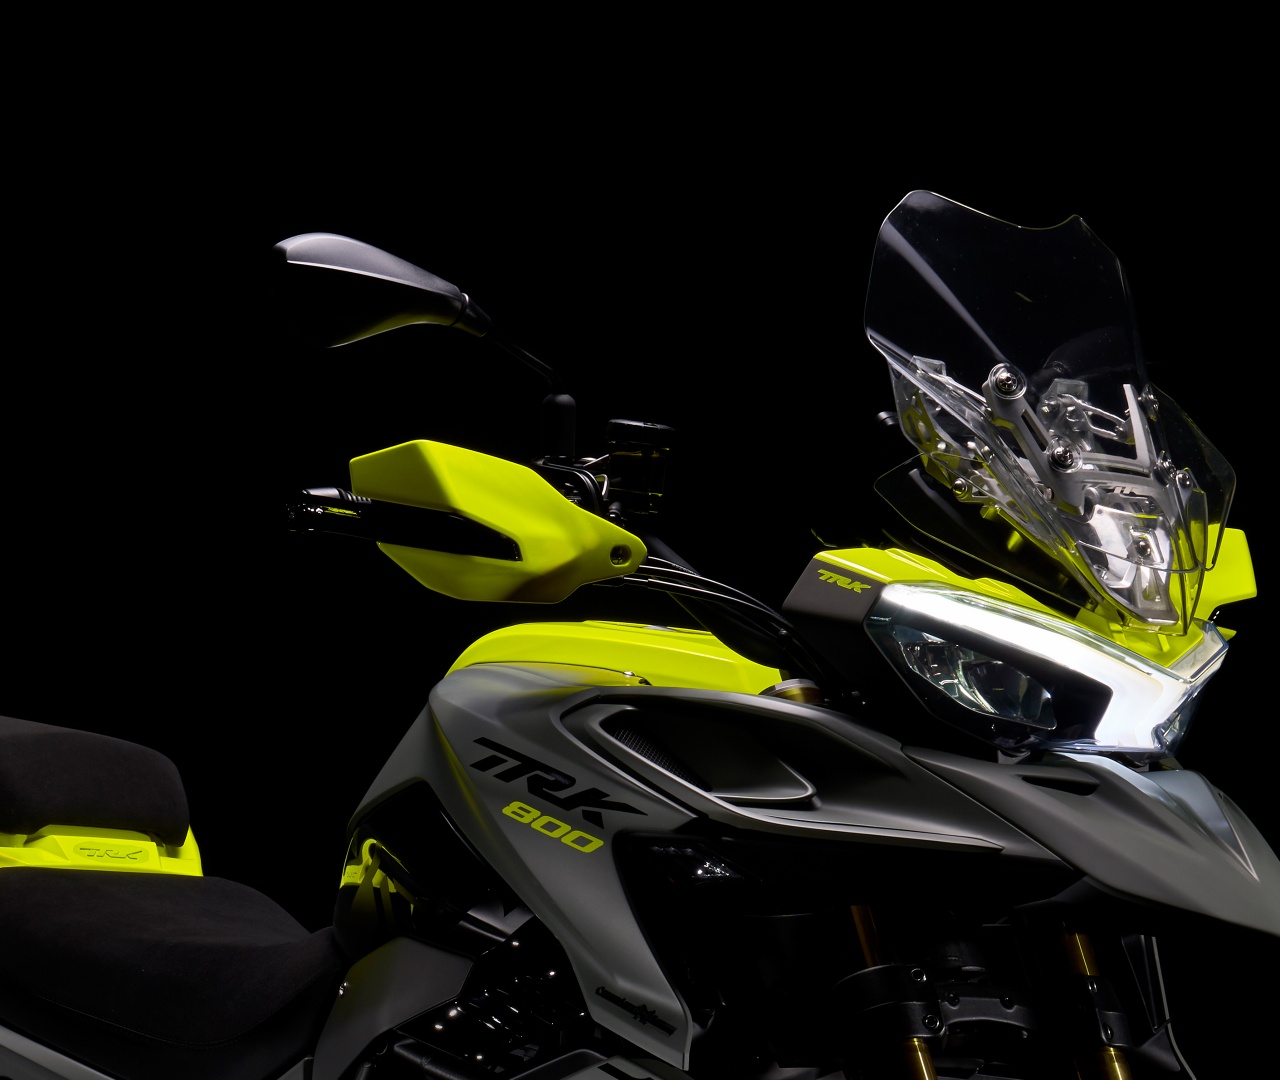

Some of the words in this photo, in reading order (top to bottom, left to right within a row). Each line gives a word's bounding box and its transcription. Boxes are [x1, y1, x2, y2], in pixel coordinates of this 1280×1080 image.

[817, 568, 872, 593] TRK
[469, 736, 648, 829] TRK
[502, 801, 605, 853] 800
[79, 847, 143, 861] TRK
